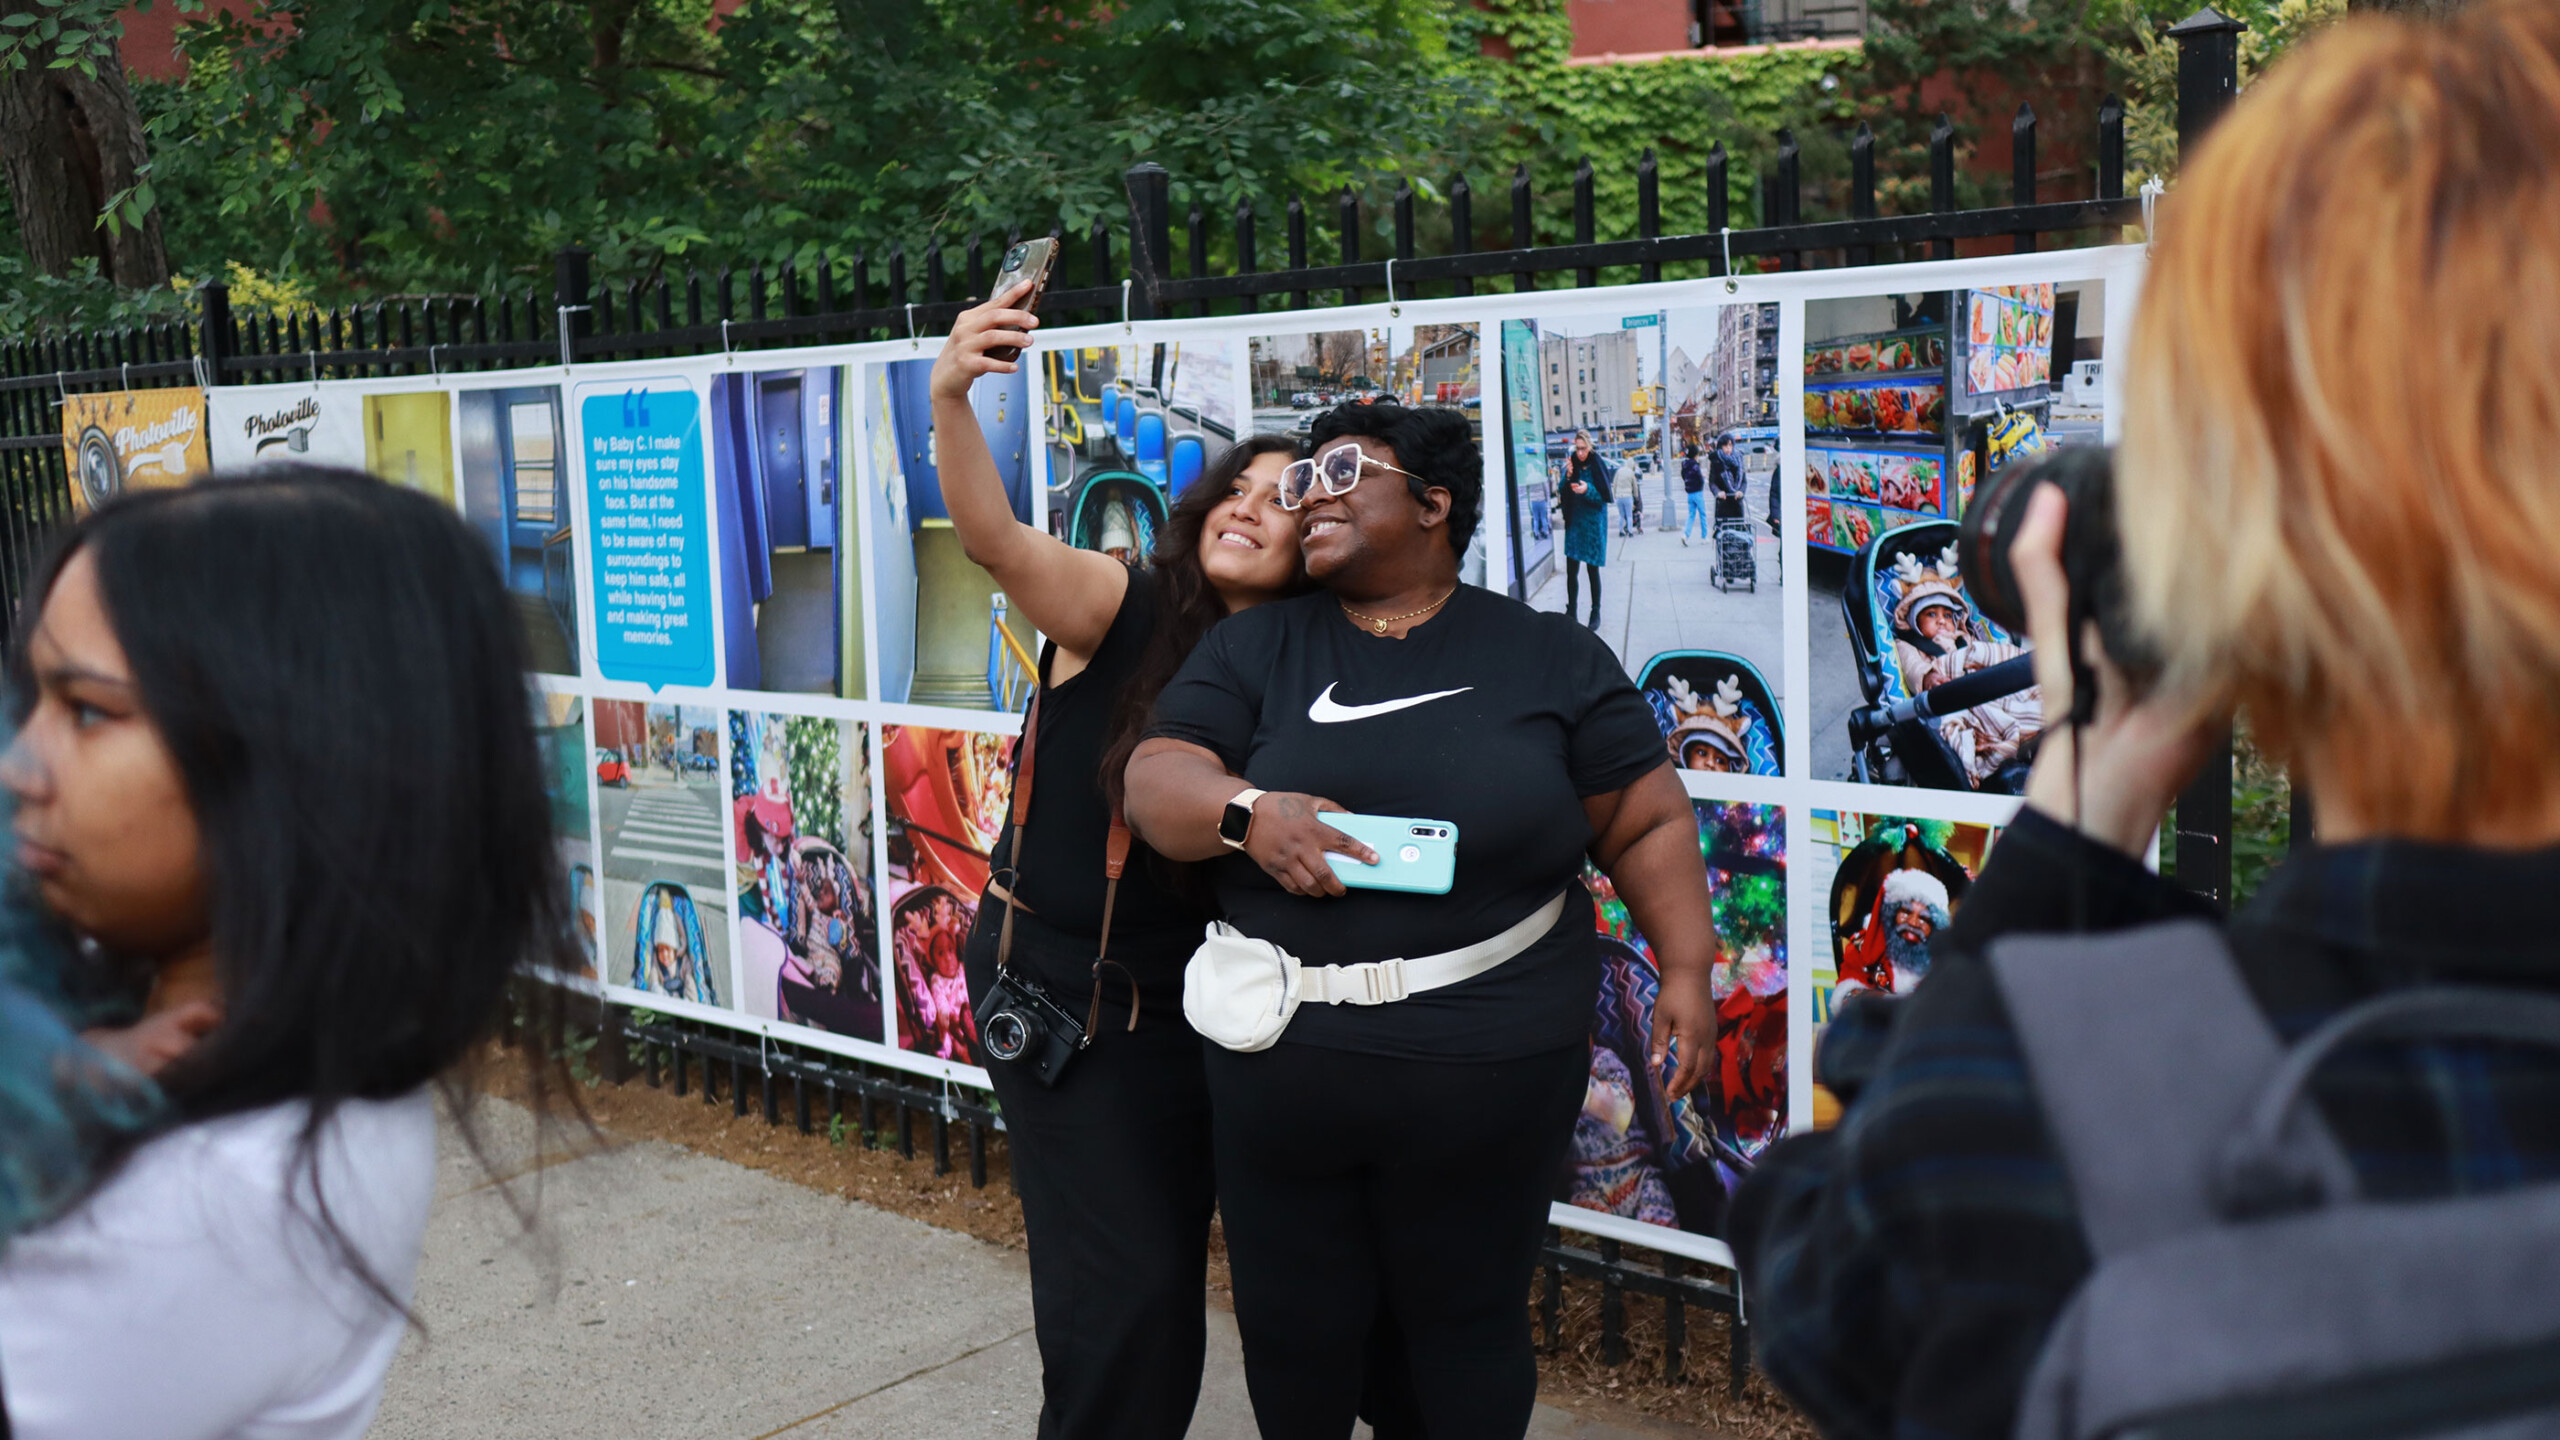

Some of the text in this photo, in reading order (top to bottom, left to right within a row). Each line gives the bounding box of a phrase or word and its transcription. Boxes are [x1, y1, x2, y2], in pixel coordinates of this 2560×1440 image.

[244, 396, 321, 438] Photoville
[115, 405, 198, 456] Photoville
[593, 437, 608, 455] My
[610, 436, 634, 454] Baby
[636, 435, 647, 450] C.
[654, 434, 681, 450] make
[596, 455, 680, 474] sure my eyes stay
[598, 475, 678, 490] on his handsome
[605, 494, 675, 509] face. But at the
[601, 516, 626, 529] same
[628, 513, 651, 530] time,
[658, 513, 683, 529] need
[601, 533, 685, 552] to be aware of my
[606, 552, 682, 571] surroundings to
[604, 570, 686, 589] keep him safe, all
[608, 590, 685, 611] while having fun
[607, 609, 688, 630] and making great
[623, 629, 673, 645] memories.
